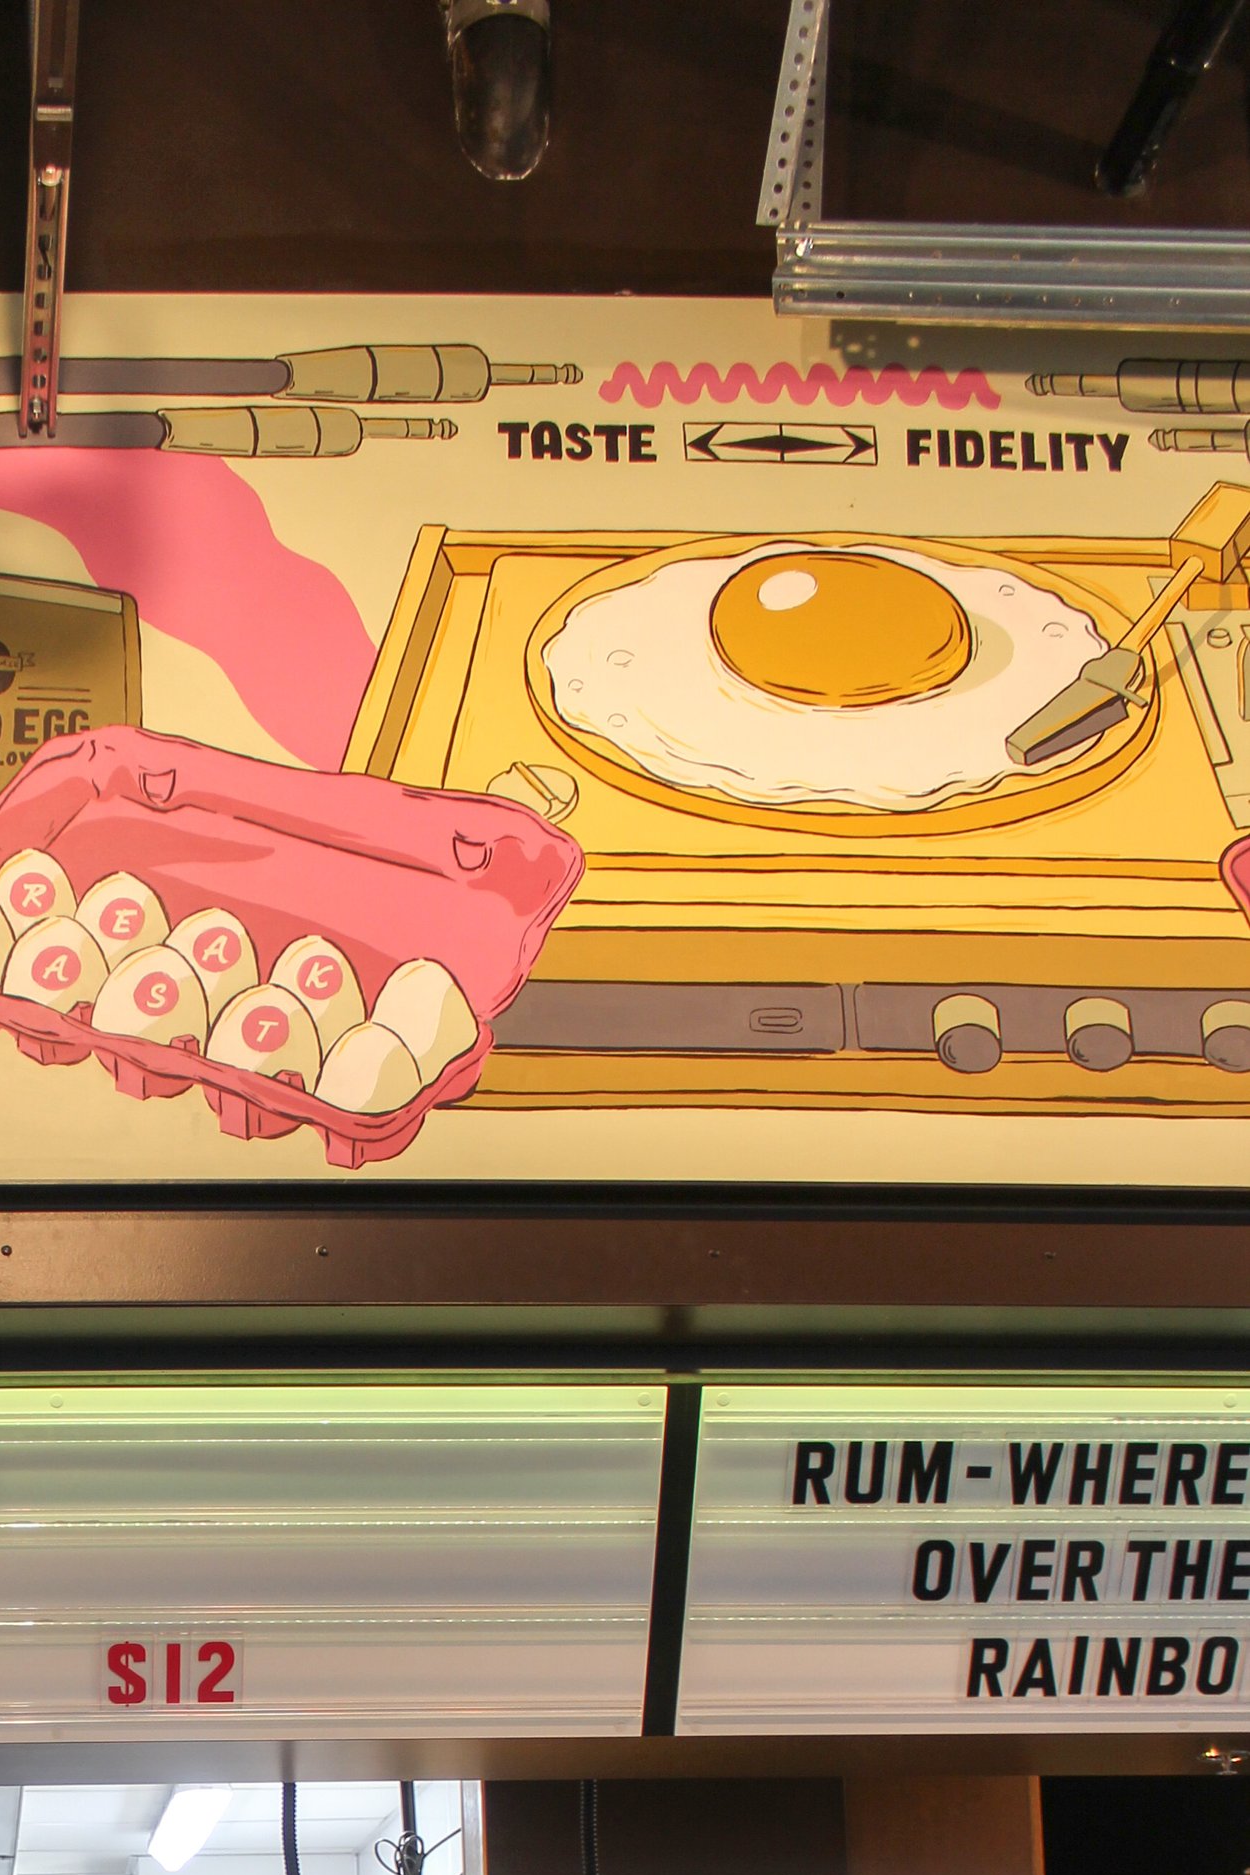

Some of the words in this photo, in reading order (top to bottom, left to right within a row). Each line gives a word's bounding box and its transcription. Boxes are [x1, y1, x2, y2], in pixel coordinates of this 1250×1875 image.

[497, 421, 657, 462] TASTE
[907, 429, 1130, 471] FIDELITY
[912, 1539, 1105, 1603] OVER
[1127, 1539, 1250, 1602] THE
[106, 1641, 236, 1706] $12
[966, 1635, 1239, 1698] RAINBO
